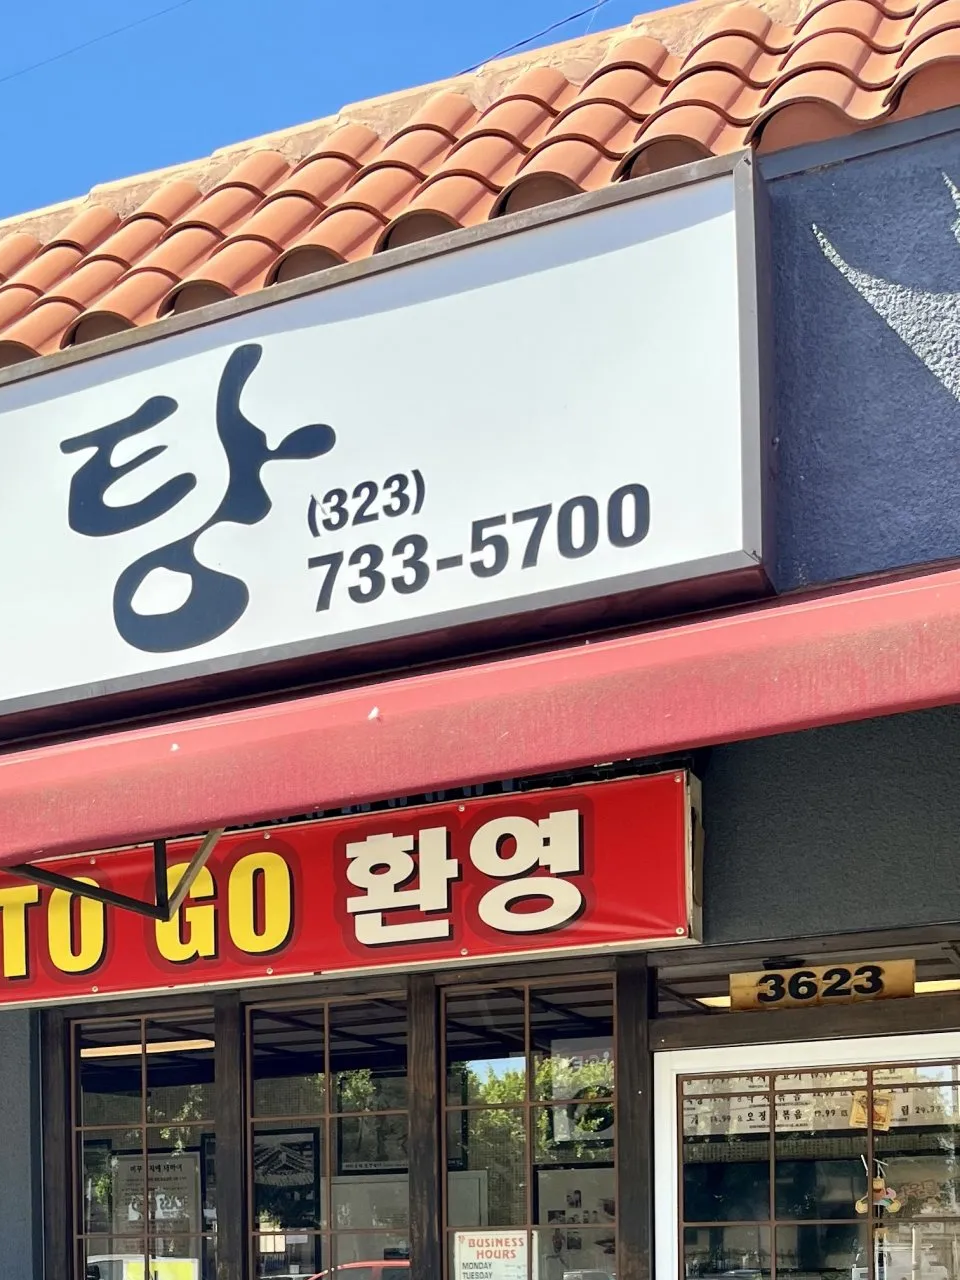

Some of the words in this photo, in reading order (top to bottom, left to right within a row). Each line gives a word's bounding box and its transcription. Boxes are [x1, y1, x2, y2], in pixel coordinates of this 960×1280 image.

[307, 469, 426, 538] (323)
[307, 483, 650, 613] 733-5700
[154, 852, 292, 963] GO
[345, 809, 583, 946] 환영
[757, 965, 884, 1003] 3623
[468, 1237, 524, 1248] BUSINESS
[476, 1249, 517, 1260] HOURS
[461, 1262, 492, 1270] MONDAY
[462, 1271, 493, 1280] TUESDAY
